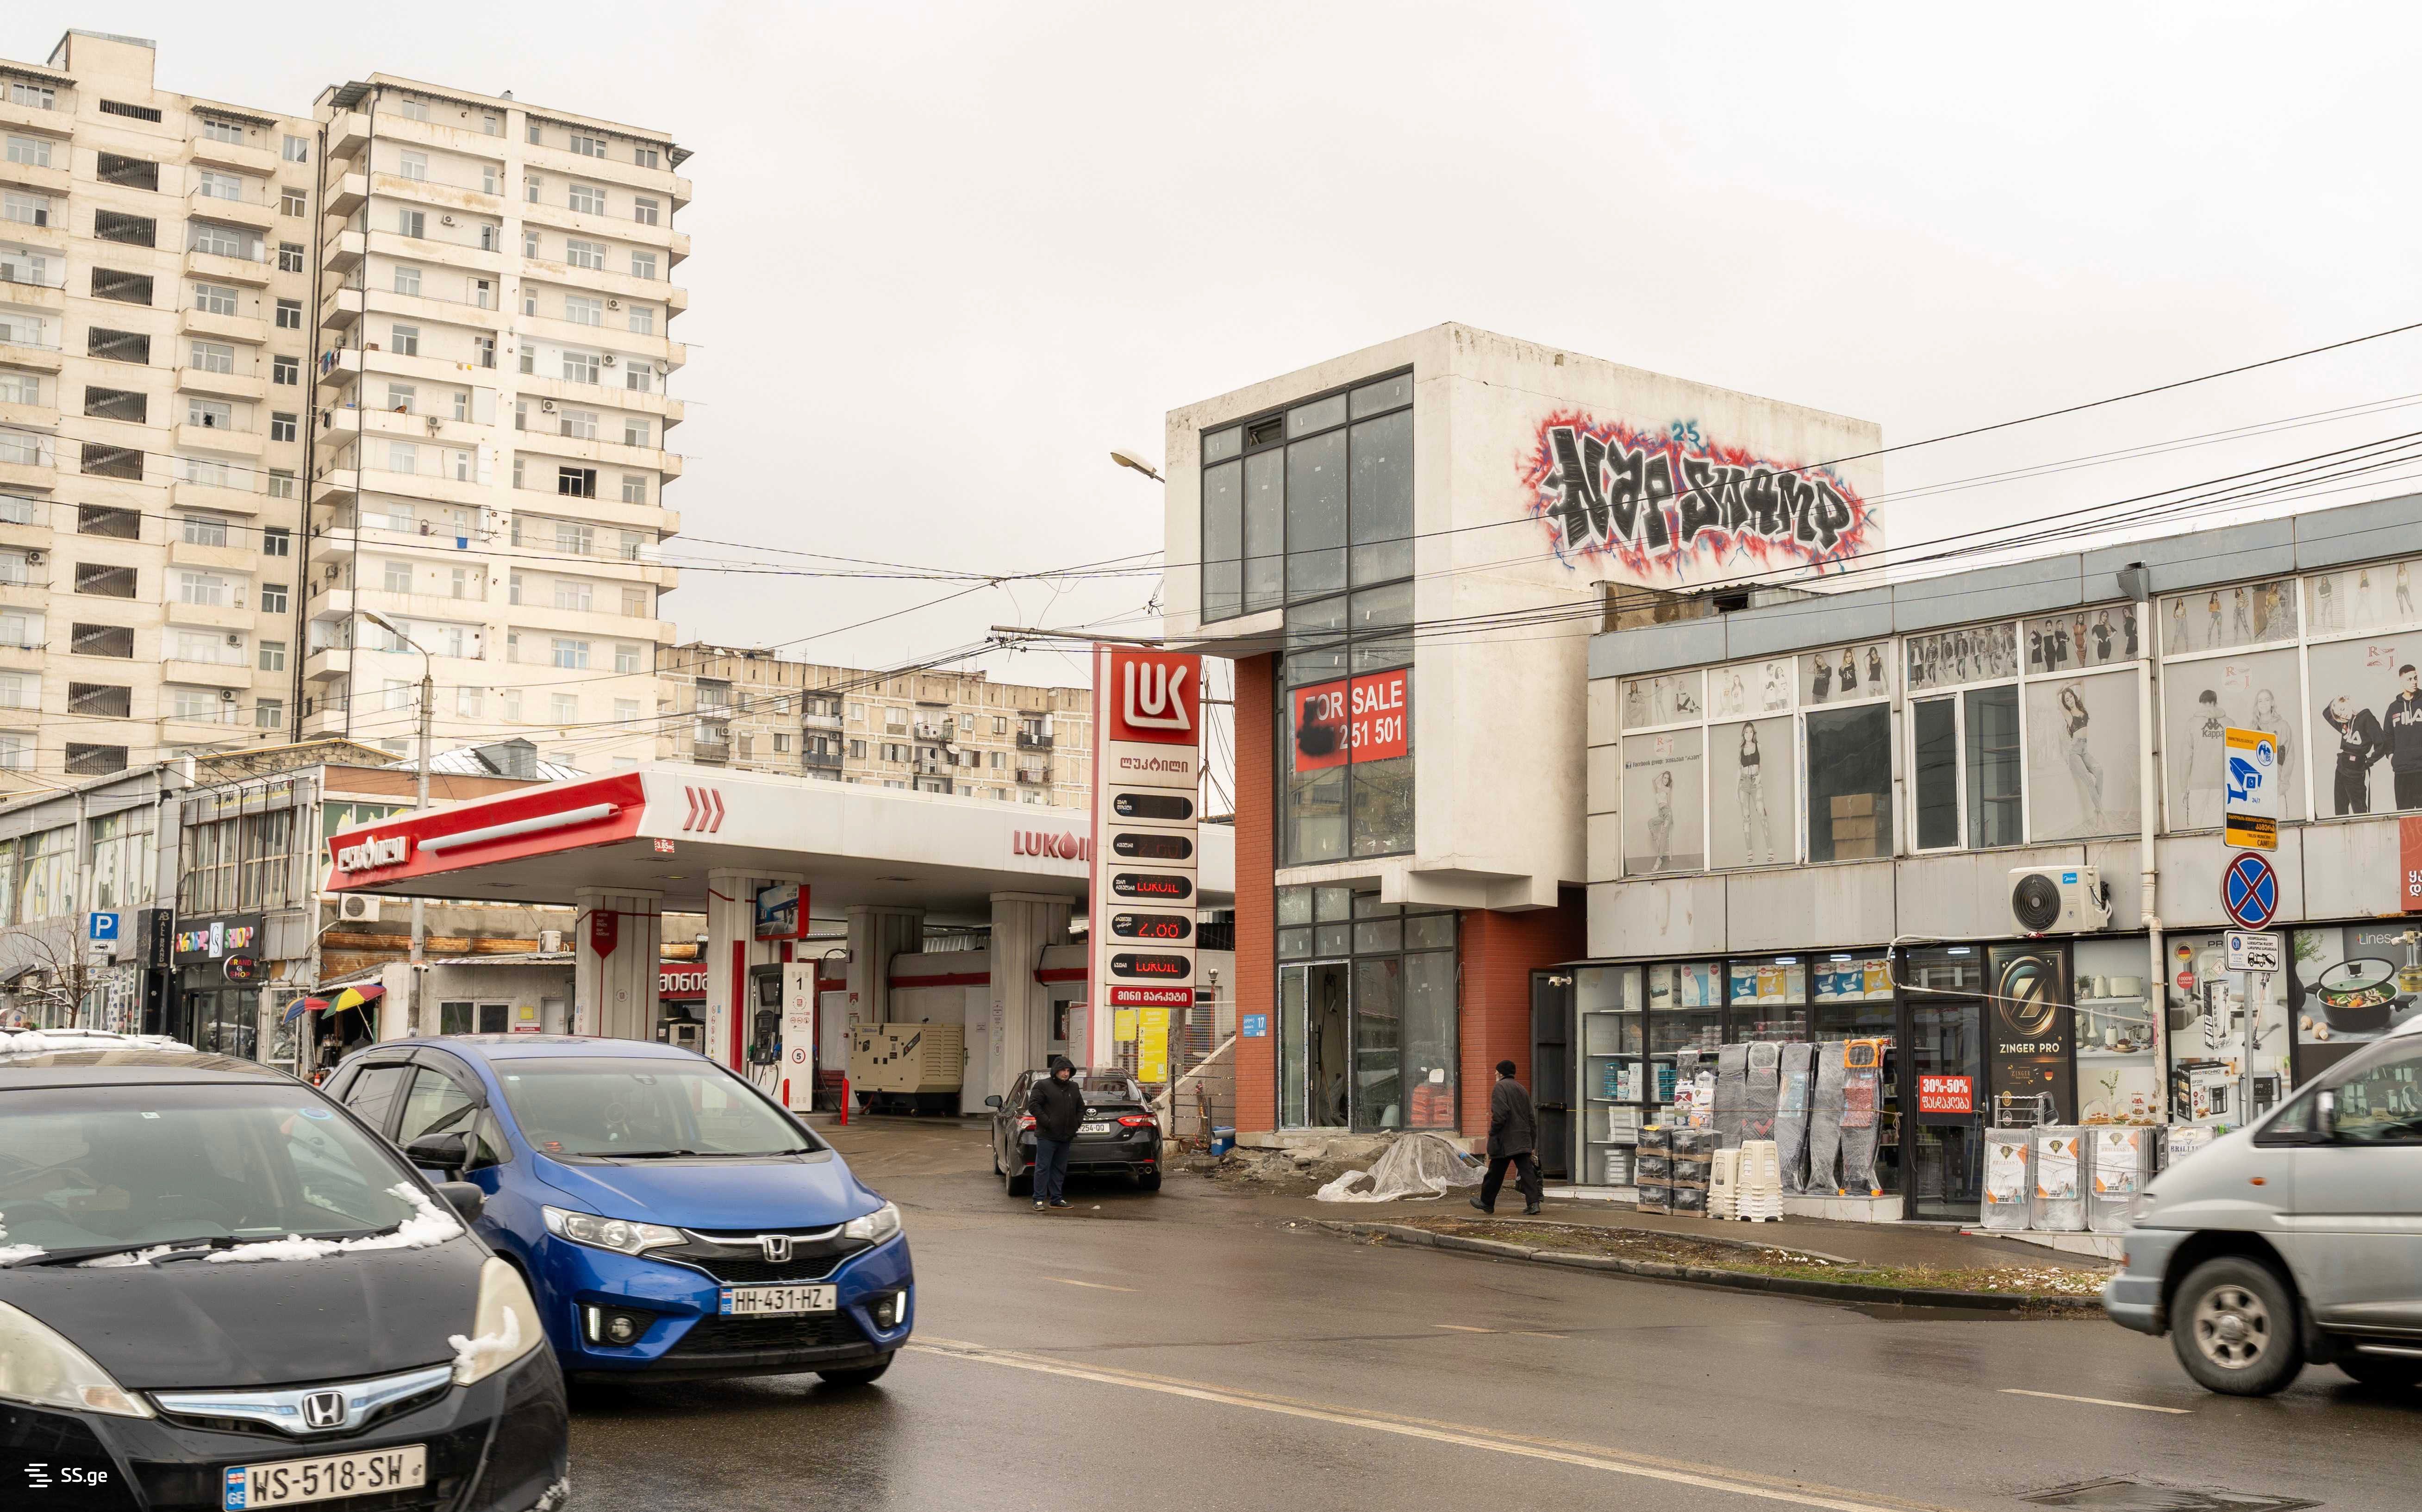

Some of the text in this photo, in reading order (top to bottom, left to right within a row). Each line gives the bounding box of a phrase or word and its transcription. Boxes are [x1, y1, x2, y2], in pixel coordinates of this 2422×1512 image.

[1672, 422, 1700, 443] 25
[1305, 680, 1403, 721] OR SALE
[1375, 715, 1401, 744] 501
[2202, 730, 2223, 739] Kappa
[1120, 757, 1188, 773] ლუკოილი
[96, 915, 112, 937] P
[225, 926, 254, 949] SHOP
[2358, 933, 2391, 945] Lines
[796, 977, 802, 990] 1
[1118, 991, 1187, 1002] მინი მარკეტი
[1258, 1017, 1265, 1028] 17
[2000, 1043, 2060, 1054] ZINGER PRO
[1923, 1078, 1968, 1093] 30%-50%
[1922, 1096, 1969, 1110] ფასდაკლება
[735, 1288, 822, 1311] HH-431-HZ
[227, 1454, 403, 1505] GE WS-518-SW
